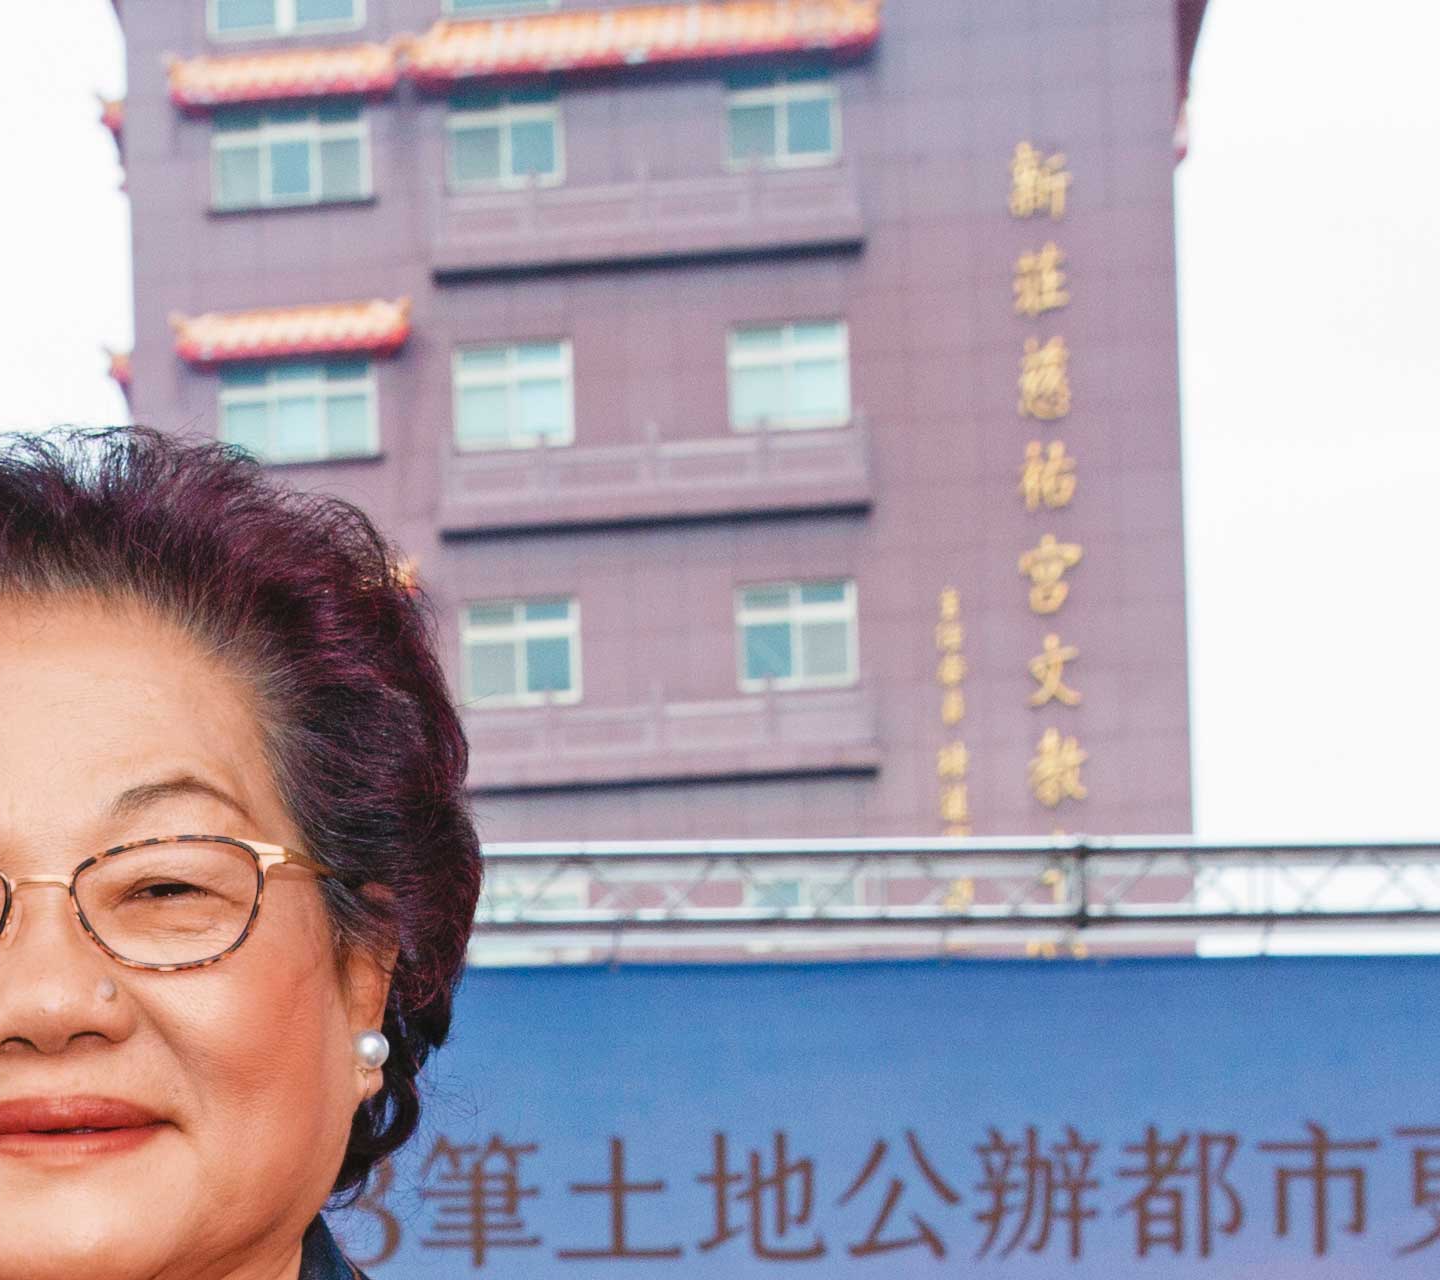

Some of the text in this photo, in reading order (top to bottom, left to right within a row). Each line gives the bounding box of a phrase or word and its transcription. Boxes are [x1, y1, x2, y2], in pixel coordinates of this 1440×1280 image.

[1006, 140, 1090, 958] 新莊慈祐宮文教
